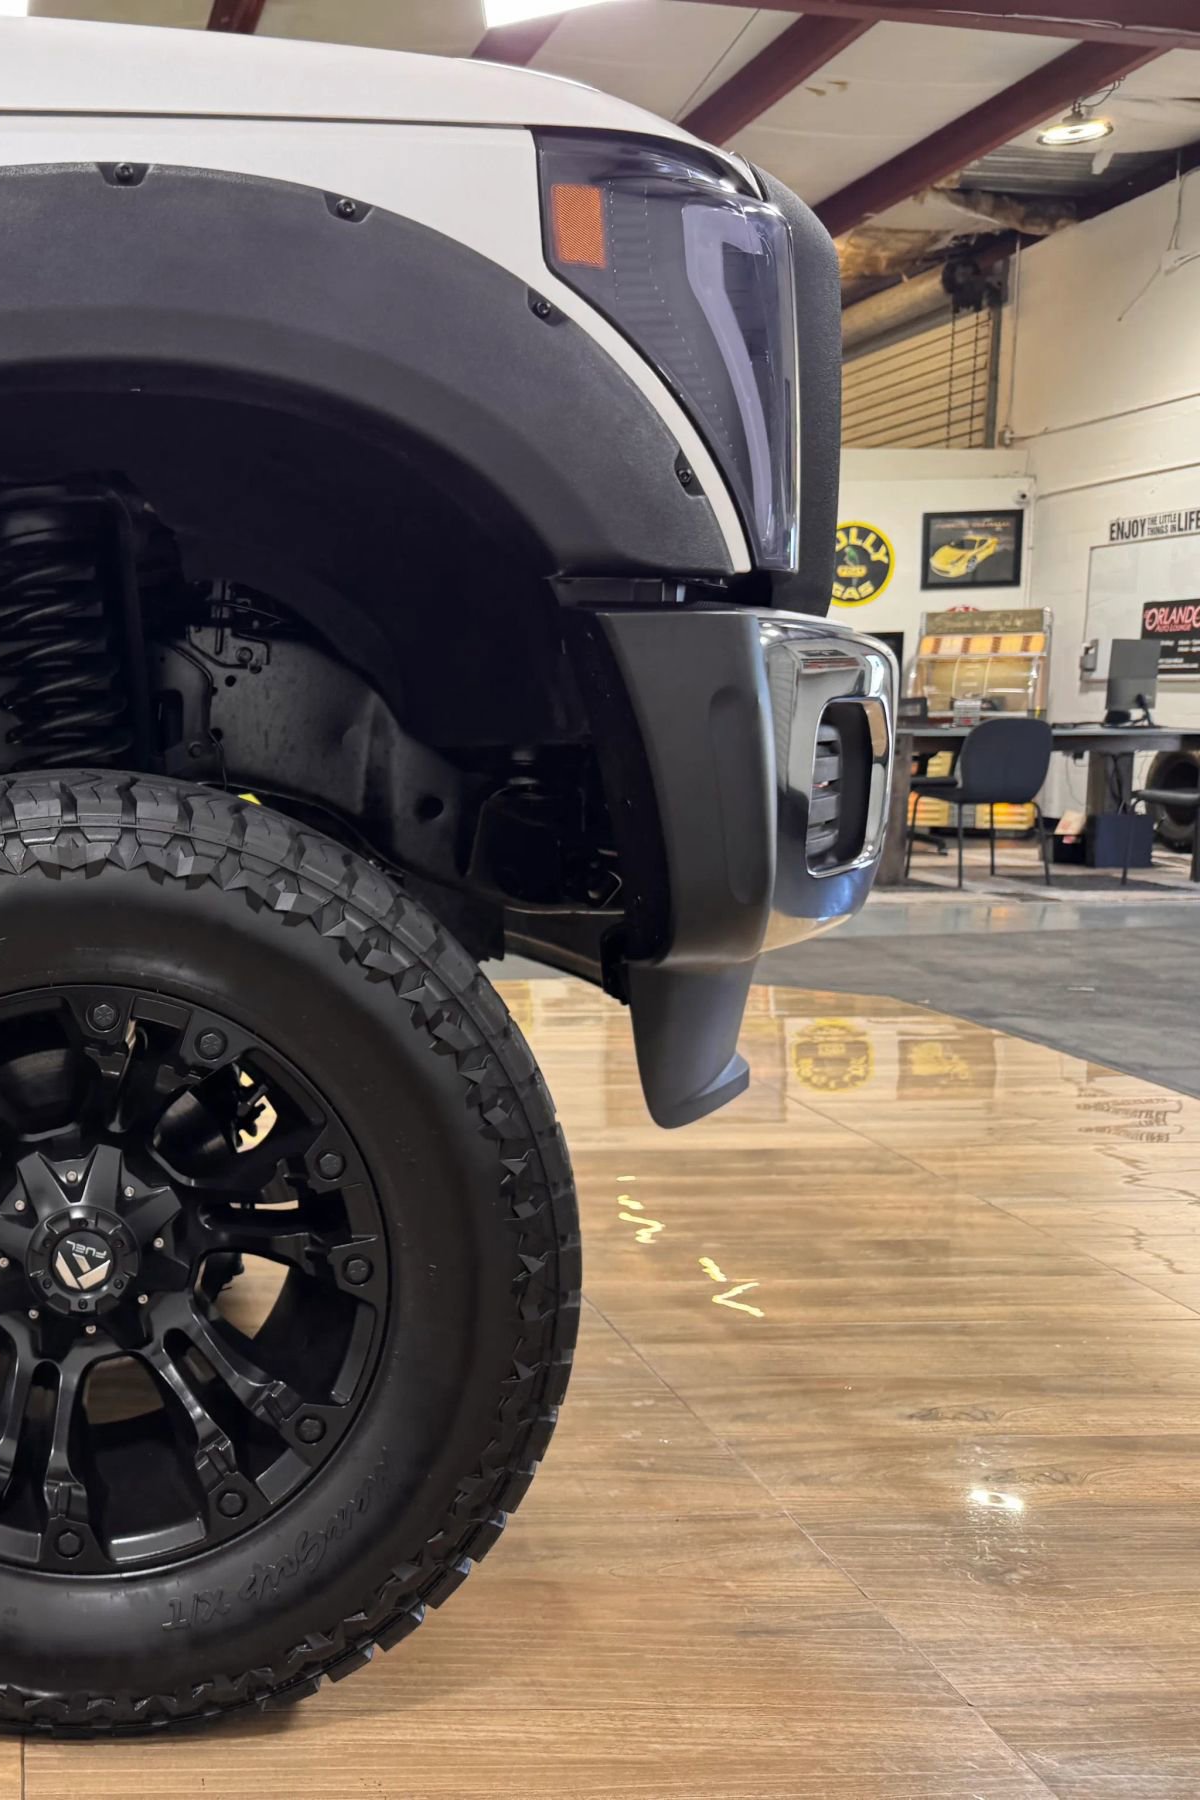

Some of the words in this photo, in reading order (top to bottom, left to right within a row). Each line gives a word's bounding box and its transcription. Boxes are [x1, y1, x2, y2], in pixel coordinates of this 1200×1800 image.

[1109, 518, 1147, 541] ENJOY
[1159, 513, 1177, 525] LITTLE
[835, 527, 889, 564] OLLY
[66, 1240, 107, 1259] FUEL
